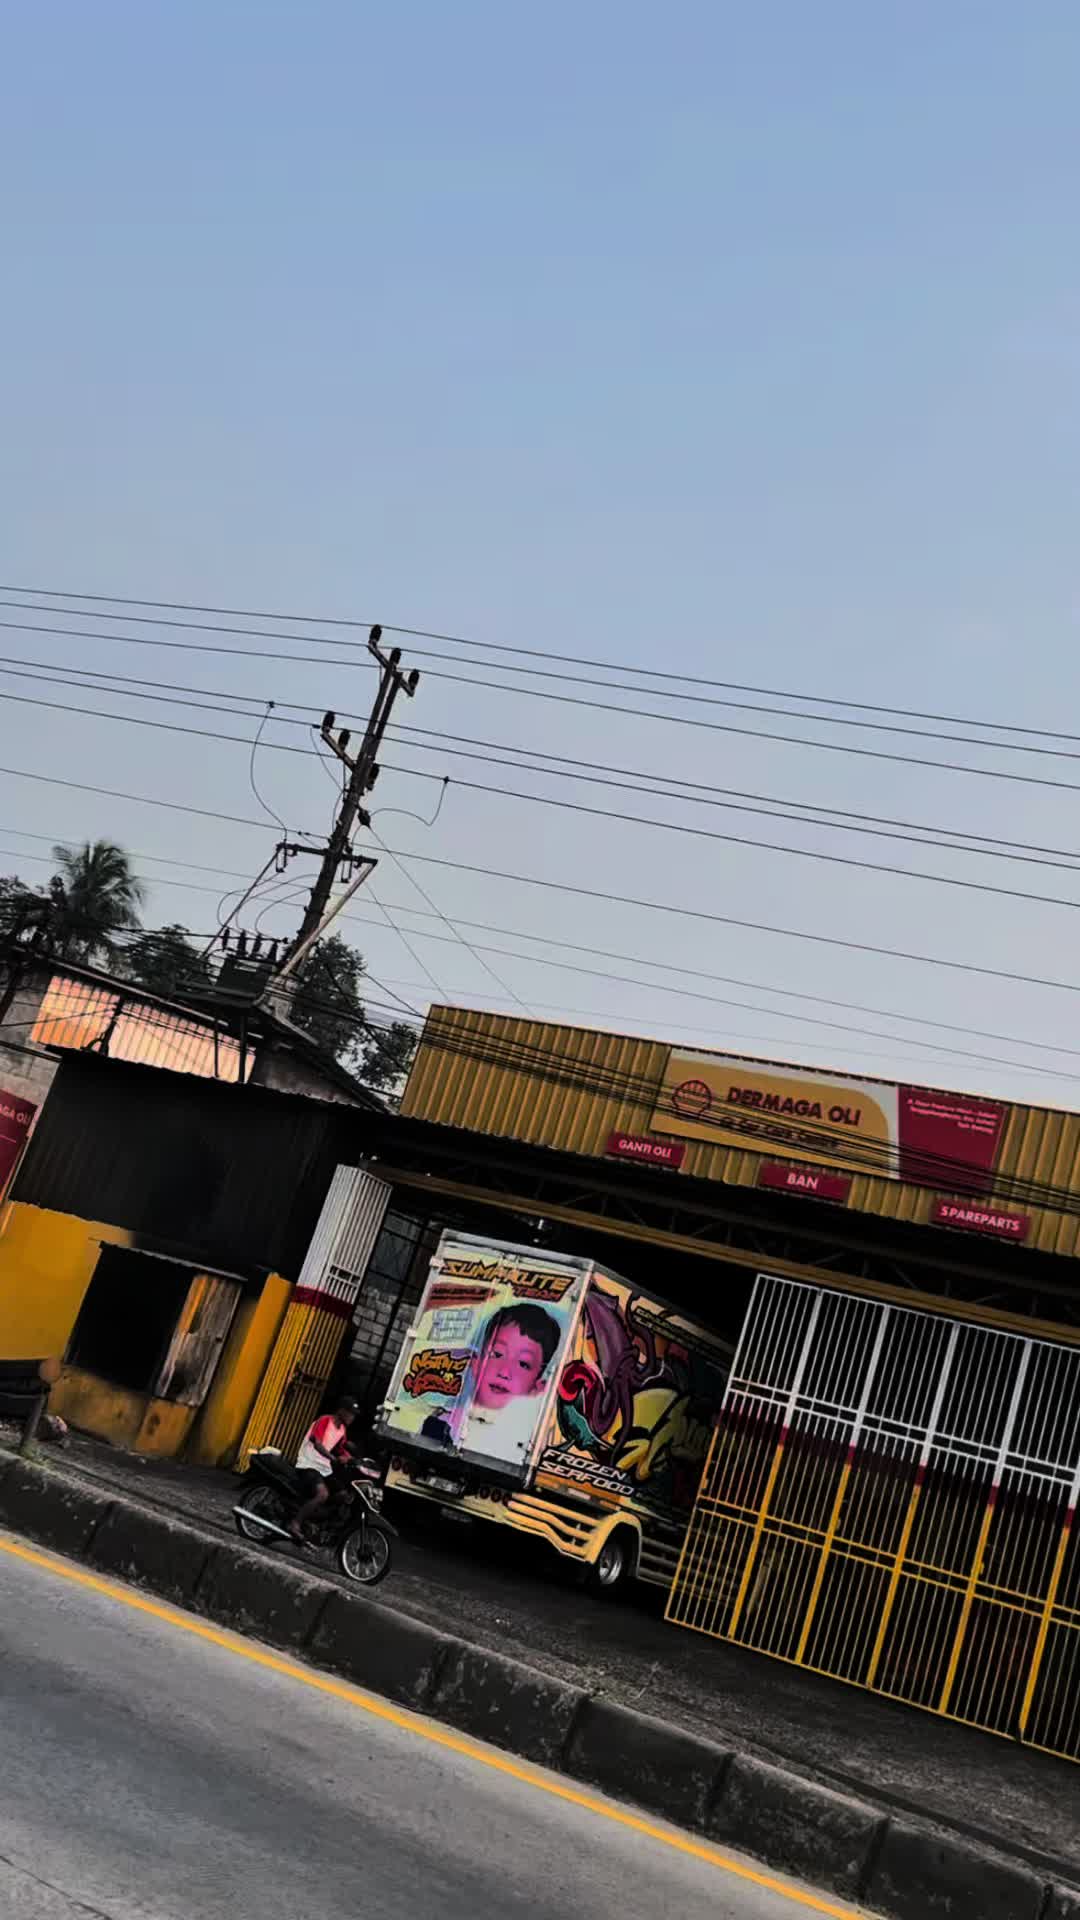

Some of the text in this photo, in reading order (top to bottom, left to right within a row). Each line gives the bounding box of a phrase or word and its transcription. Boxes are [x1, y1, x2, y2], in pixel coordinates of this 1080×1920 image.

[727, 1086, 862, 1127] DERMAGA OLI
[618, 1138, 673, 1159] GANTI OLI
[786, 1171, 819, 1190] BAN
[940, 1205, 1021, 1231] SPAREPARTS
[538, 1460, 635, 1496] SEAFOOD
[543, 1448, 627, 1480] FROZEN
